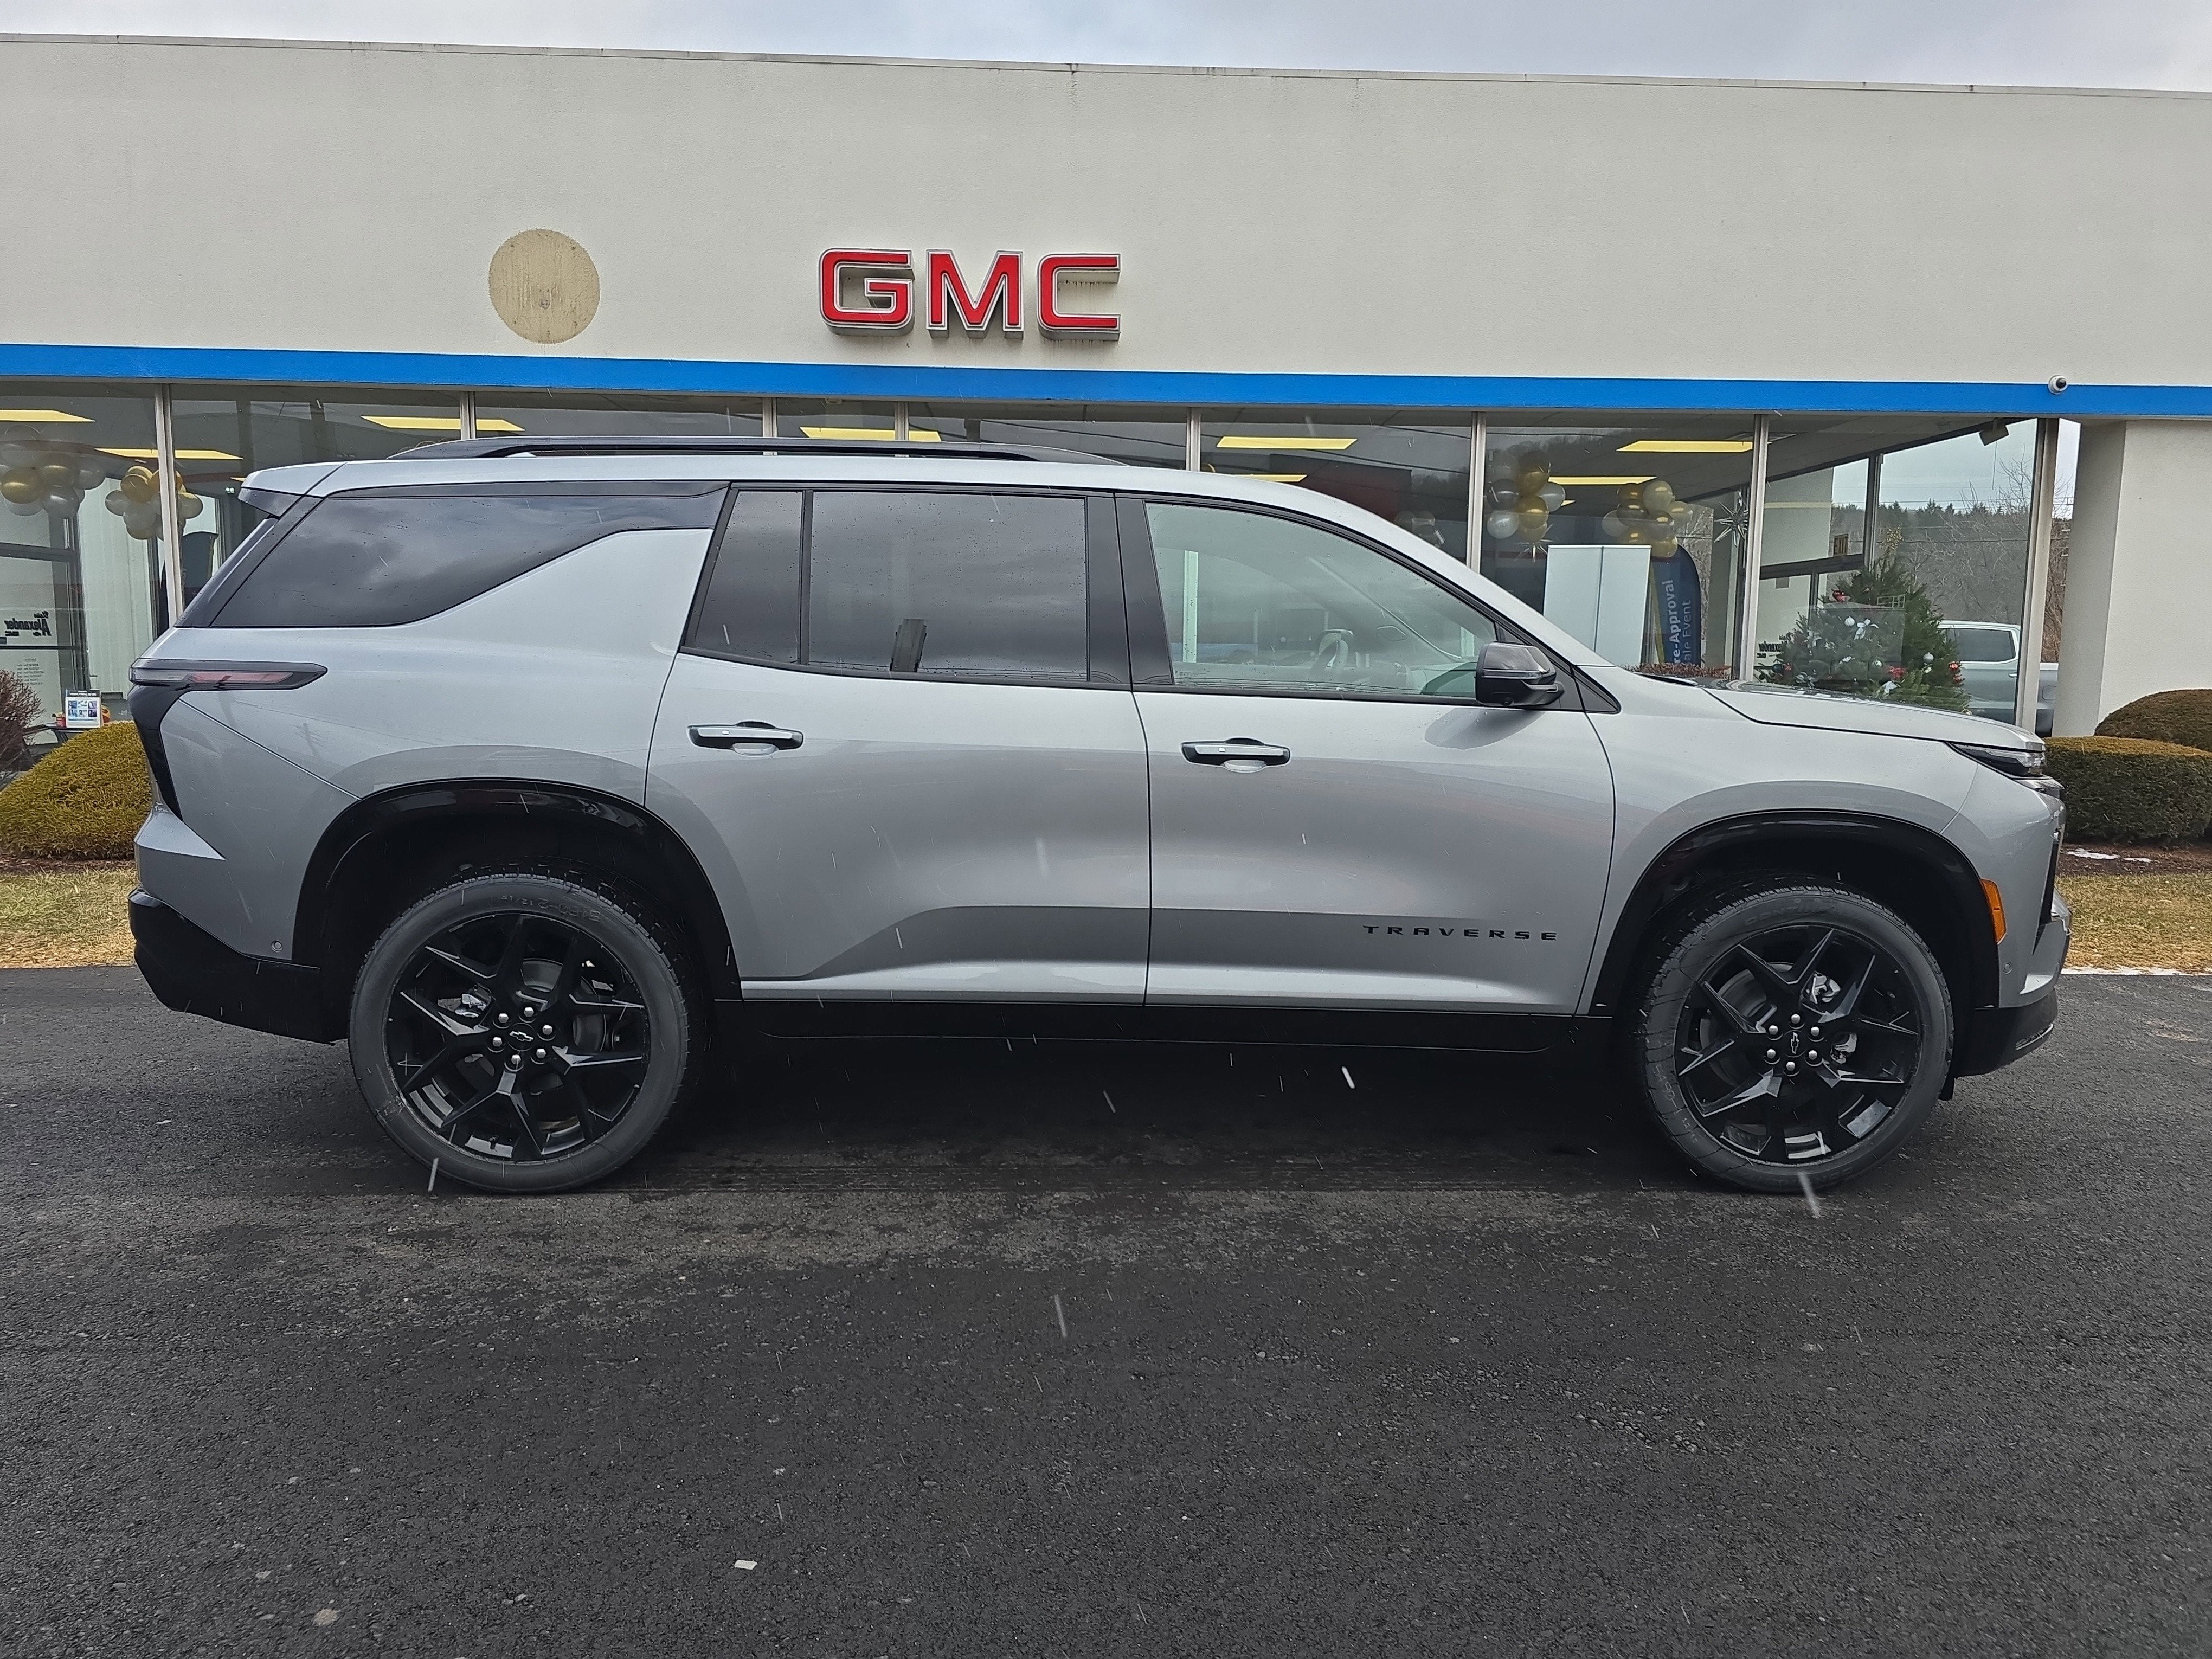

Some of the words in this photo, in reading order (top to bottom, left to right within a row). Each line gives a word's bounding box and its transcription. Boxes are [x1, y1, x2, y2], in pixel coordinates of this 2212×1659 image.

[819, 248, 1121, 340] GMC
[1662, 580, 1681, 663] re-Approval
[1682, 600, 1692, 638] Event
[1682, 642, 1692, 663] ale
[1363, 925, 1558, 941] TRAVERSE
